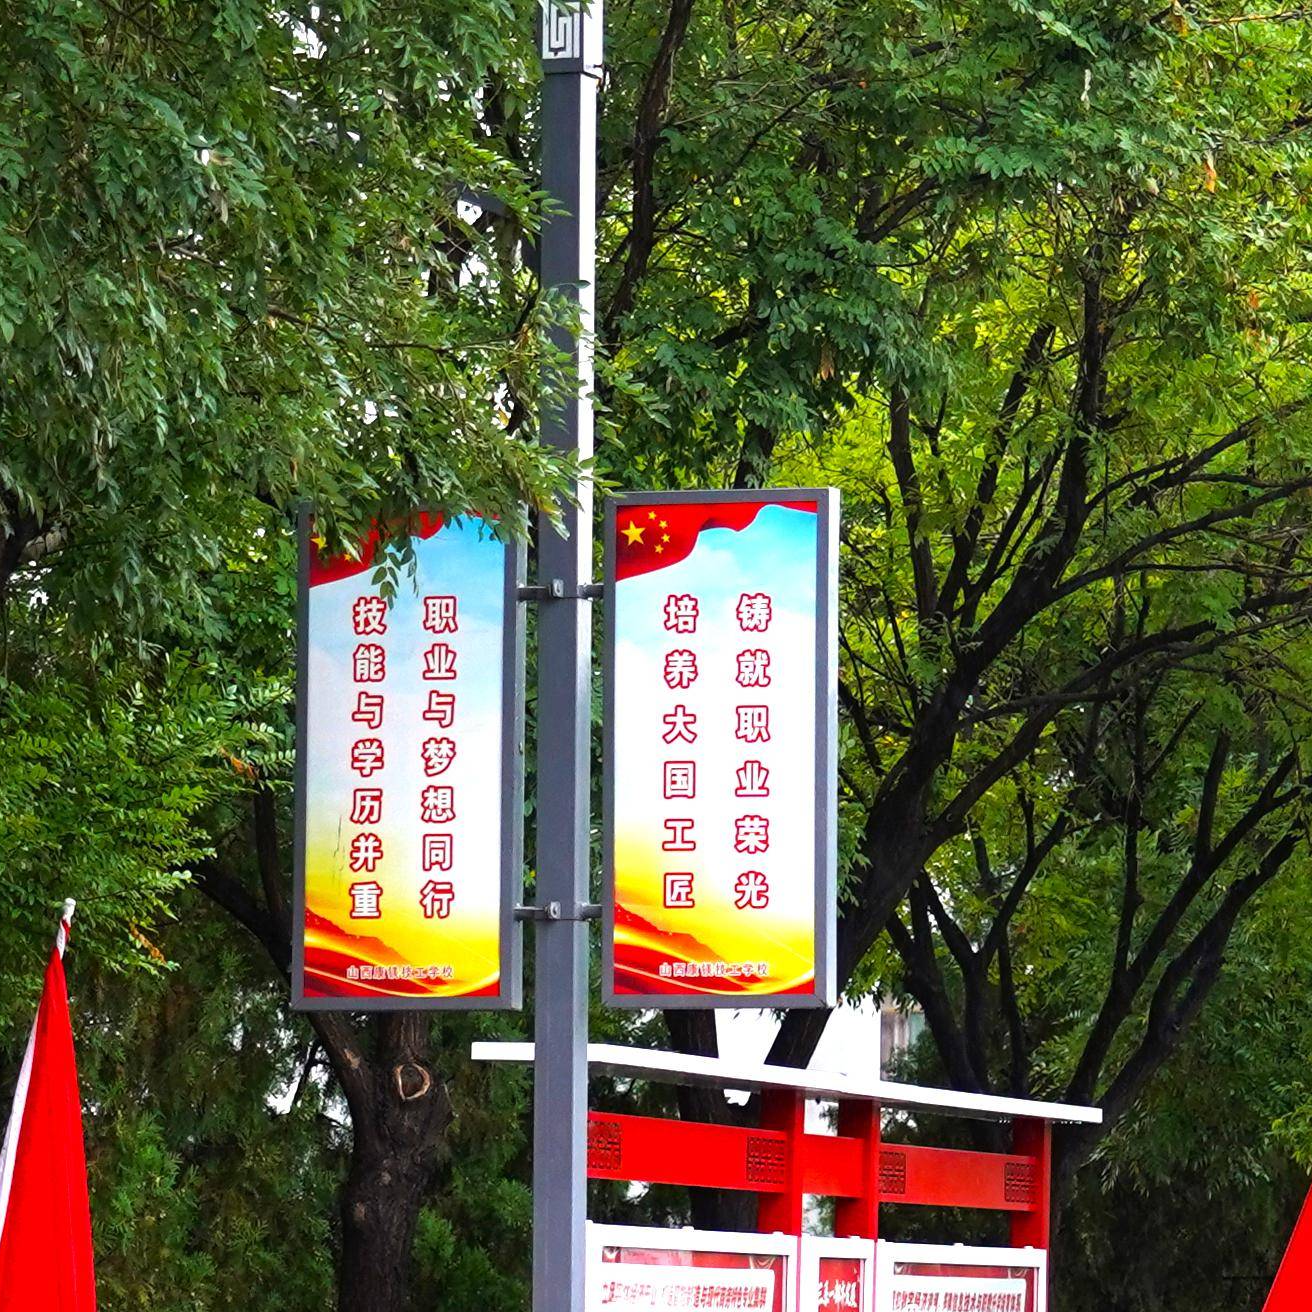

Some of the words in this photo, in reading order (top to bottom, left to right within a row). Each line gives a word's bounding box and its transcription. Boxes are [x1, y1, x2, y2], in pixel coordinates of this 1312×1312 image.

[350, 596, 387, 920] 技能与学历并重
[421, 595, 458, 919] 职业与梦想同行
[662, 594, 699, 909] 培养大国工匠
[734, 593, 771, 909] 铸就职业荣光
